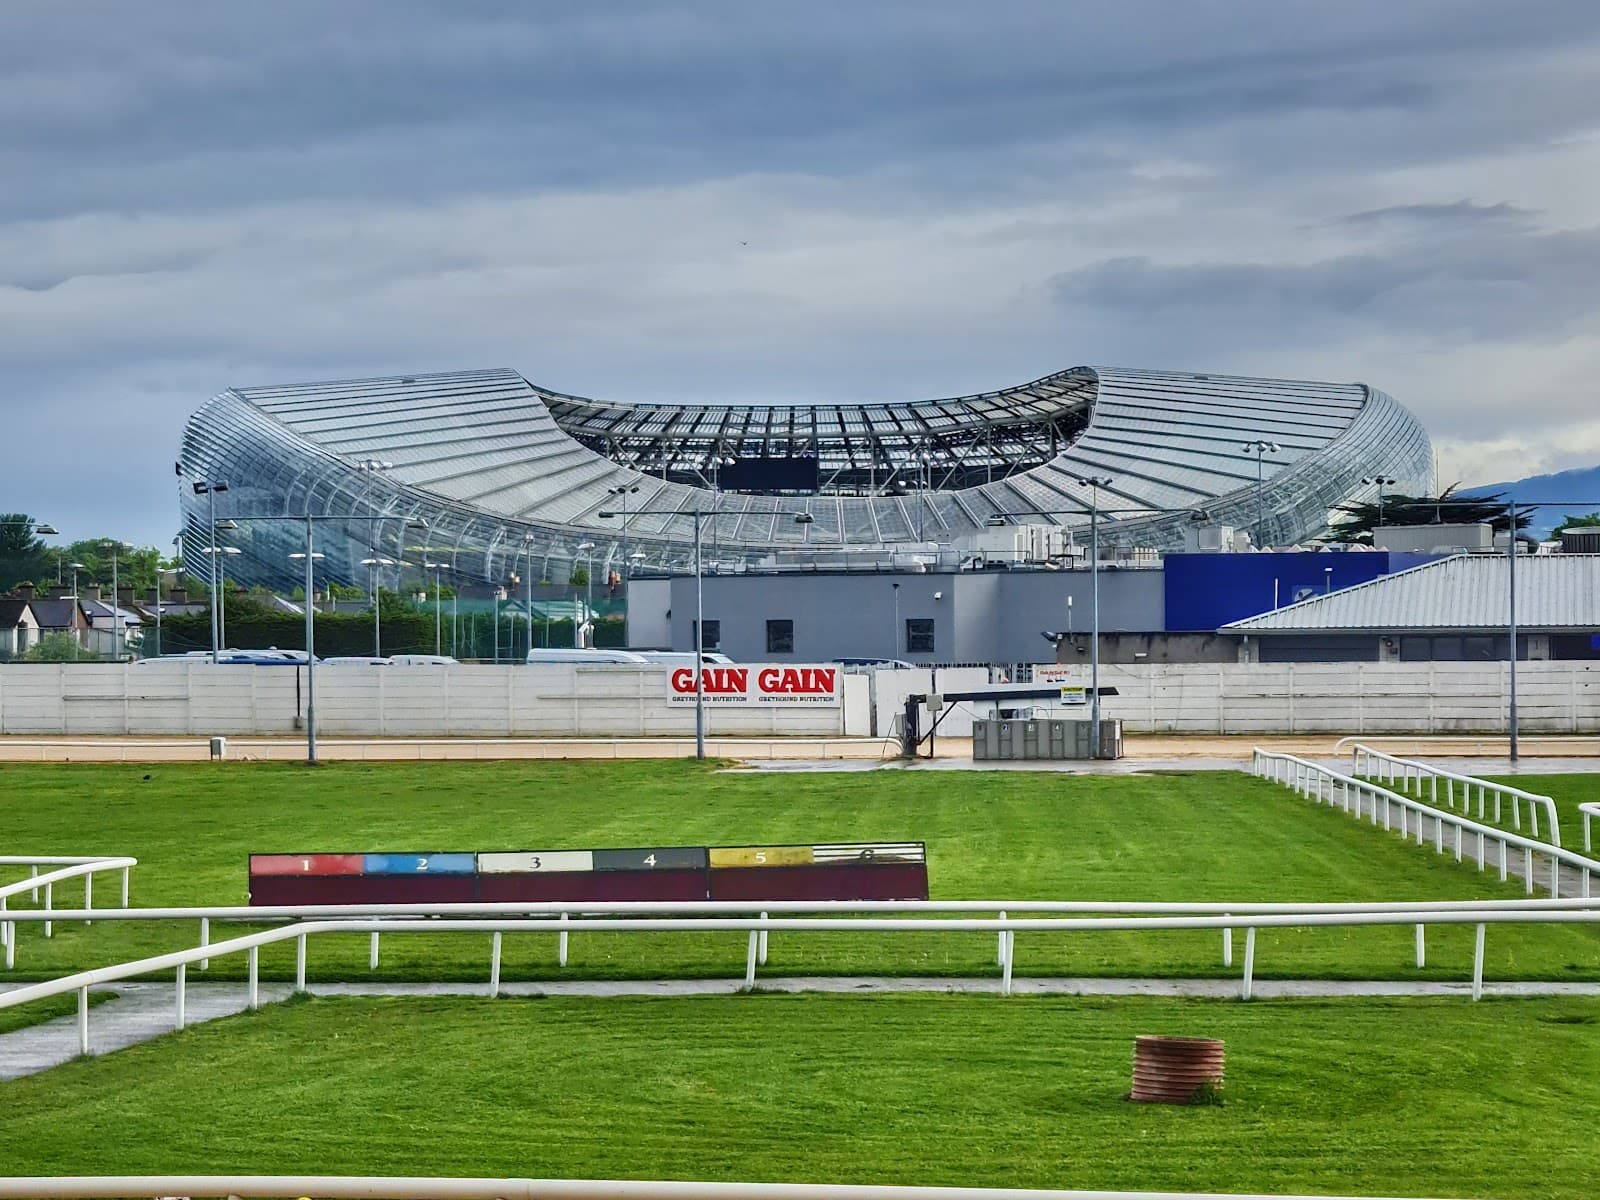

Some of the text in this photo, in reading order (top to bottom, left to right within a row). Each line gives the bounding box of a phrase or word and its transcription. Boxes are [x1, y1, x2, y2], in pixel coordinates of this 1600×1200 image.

[671, 669, 748, 692] GAIN
[758, 669, 836, 692] GAIN
[416, 858, 428, 870] 2
[529, 856, 541, 869] 3
[643, 853, 657, 867] 4
[755, 851, 767, 864] 5
[302, 859, 310, 871] 1
